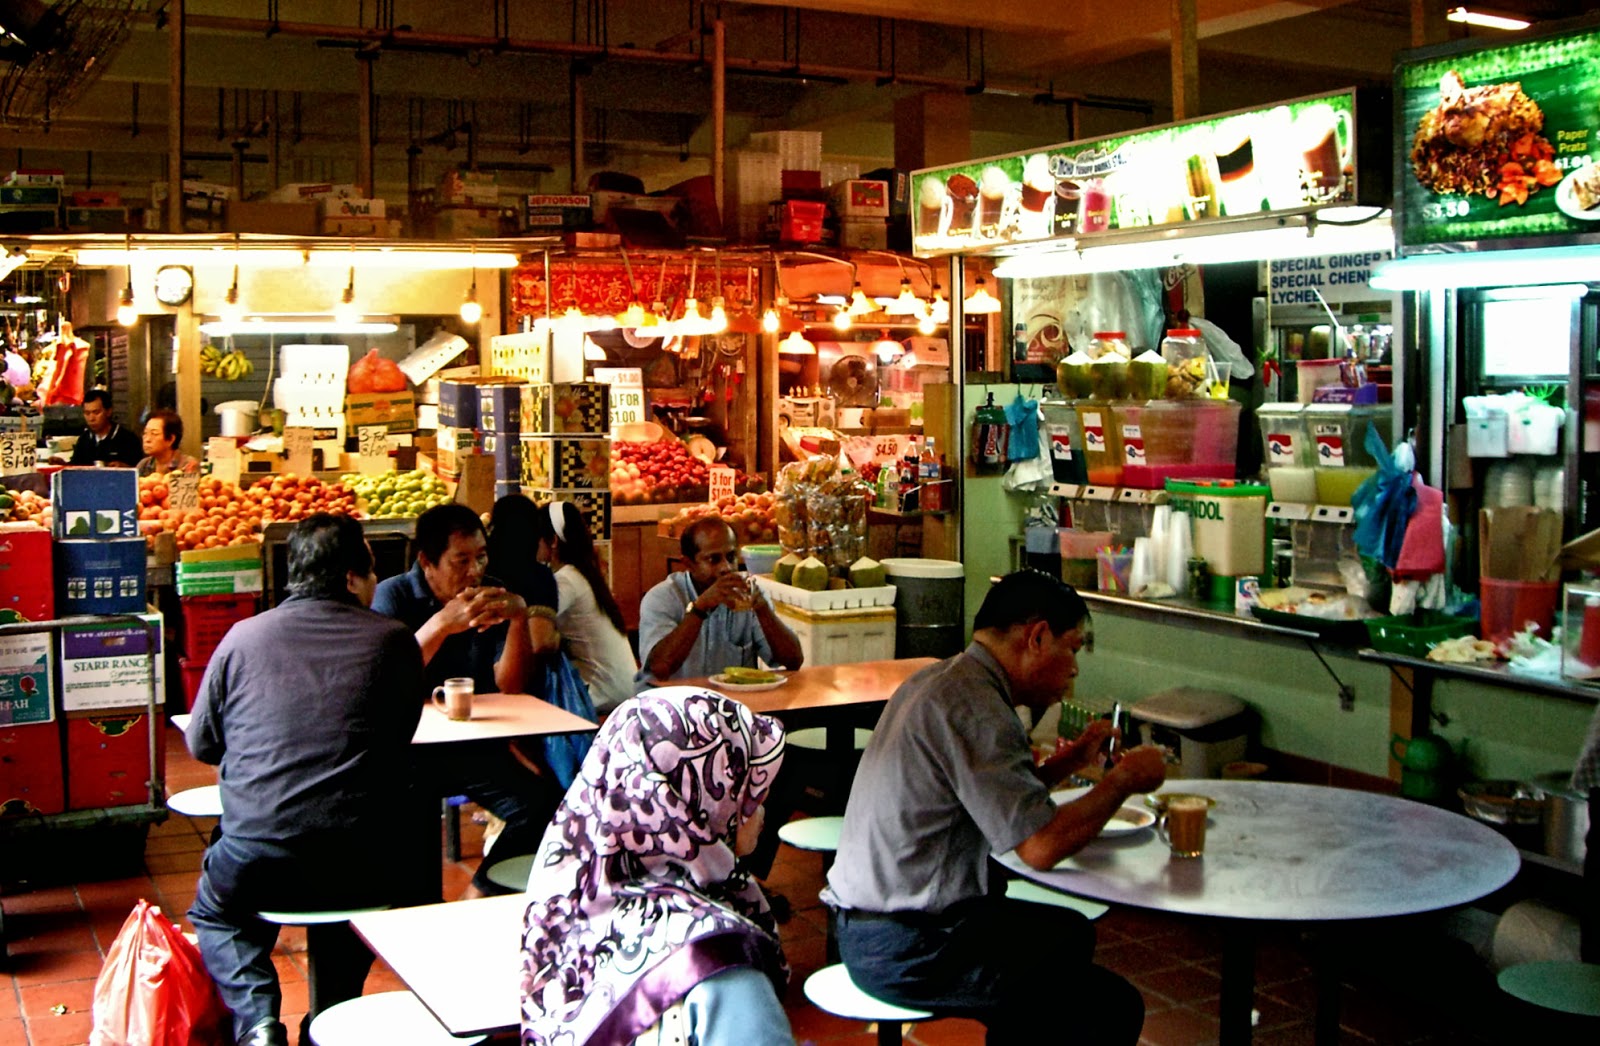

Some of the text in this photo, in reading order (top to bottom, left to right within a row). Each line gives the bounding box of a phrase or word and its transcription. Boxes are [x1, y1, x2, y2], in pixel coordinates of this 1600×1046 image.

[1557, 130, 1588, 141] Paper
[1558, 142, 1587, 153] Prata
[1271, 257, 1325, 274] SPECIAL
[1271, 273, 1325, 289] SPECIAL
[1271, 288, 1321, 304] LYCHEE
[619, 393, 640, 407] FOR
[875, 443, 898, 457] $4.50
[712, 472, 732, 486] 3 for
[73, 661, 110, 673] STARR
